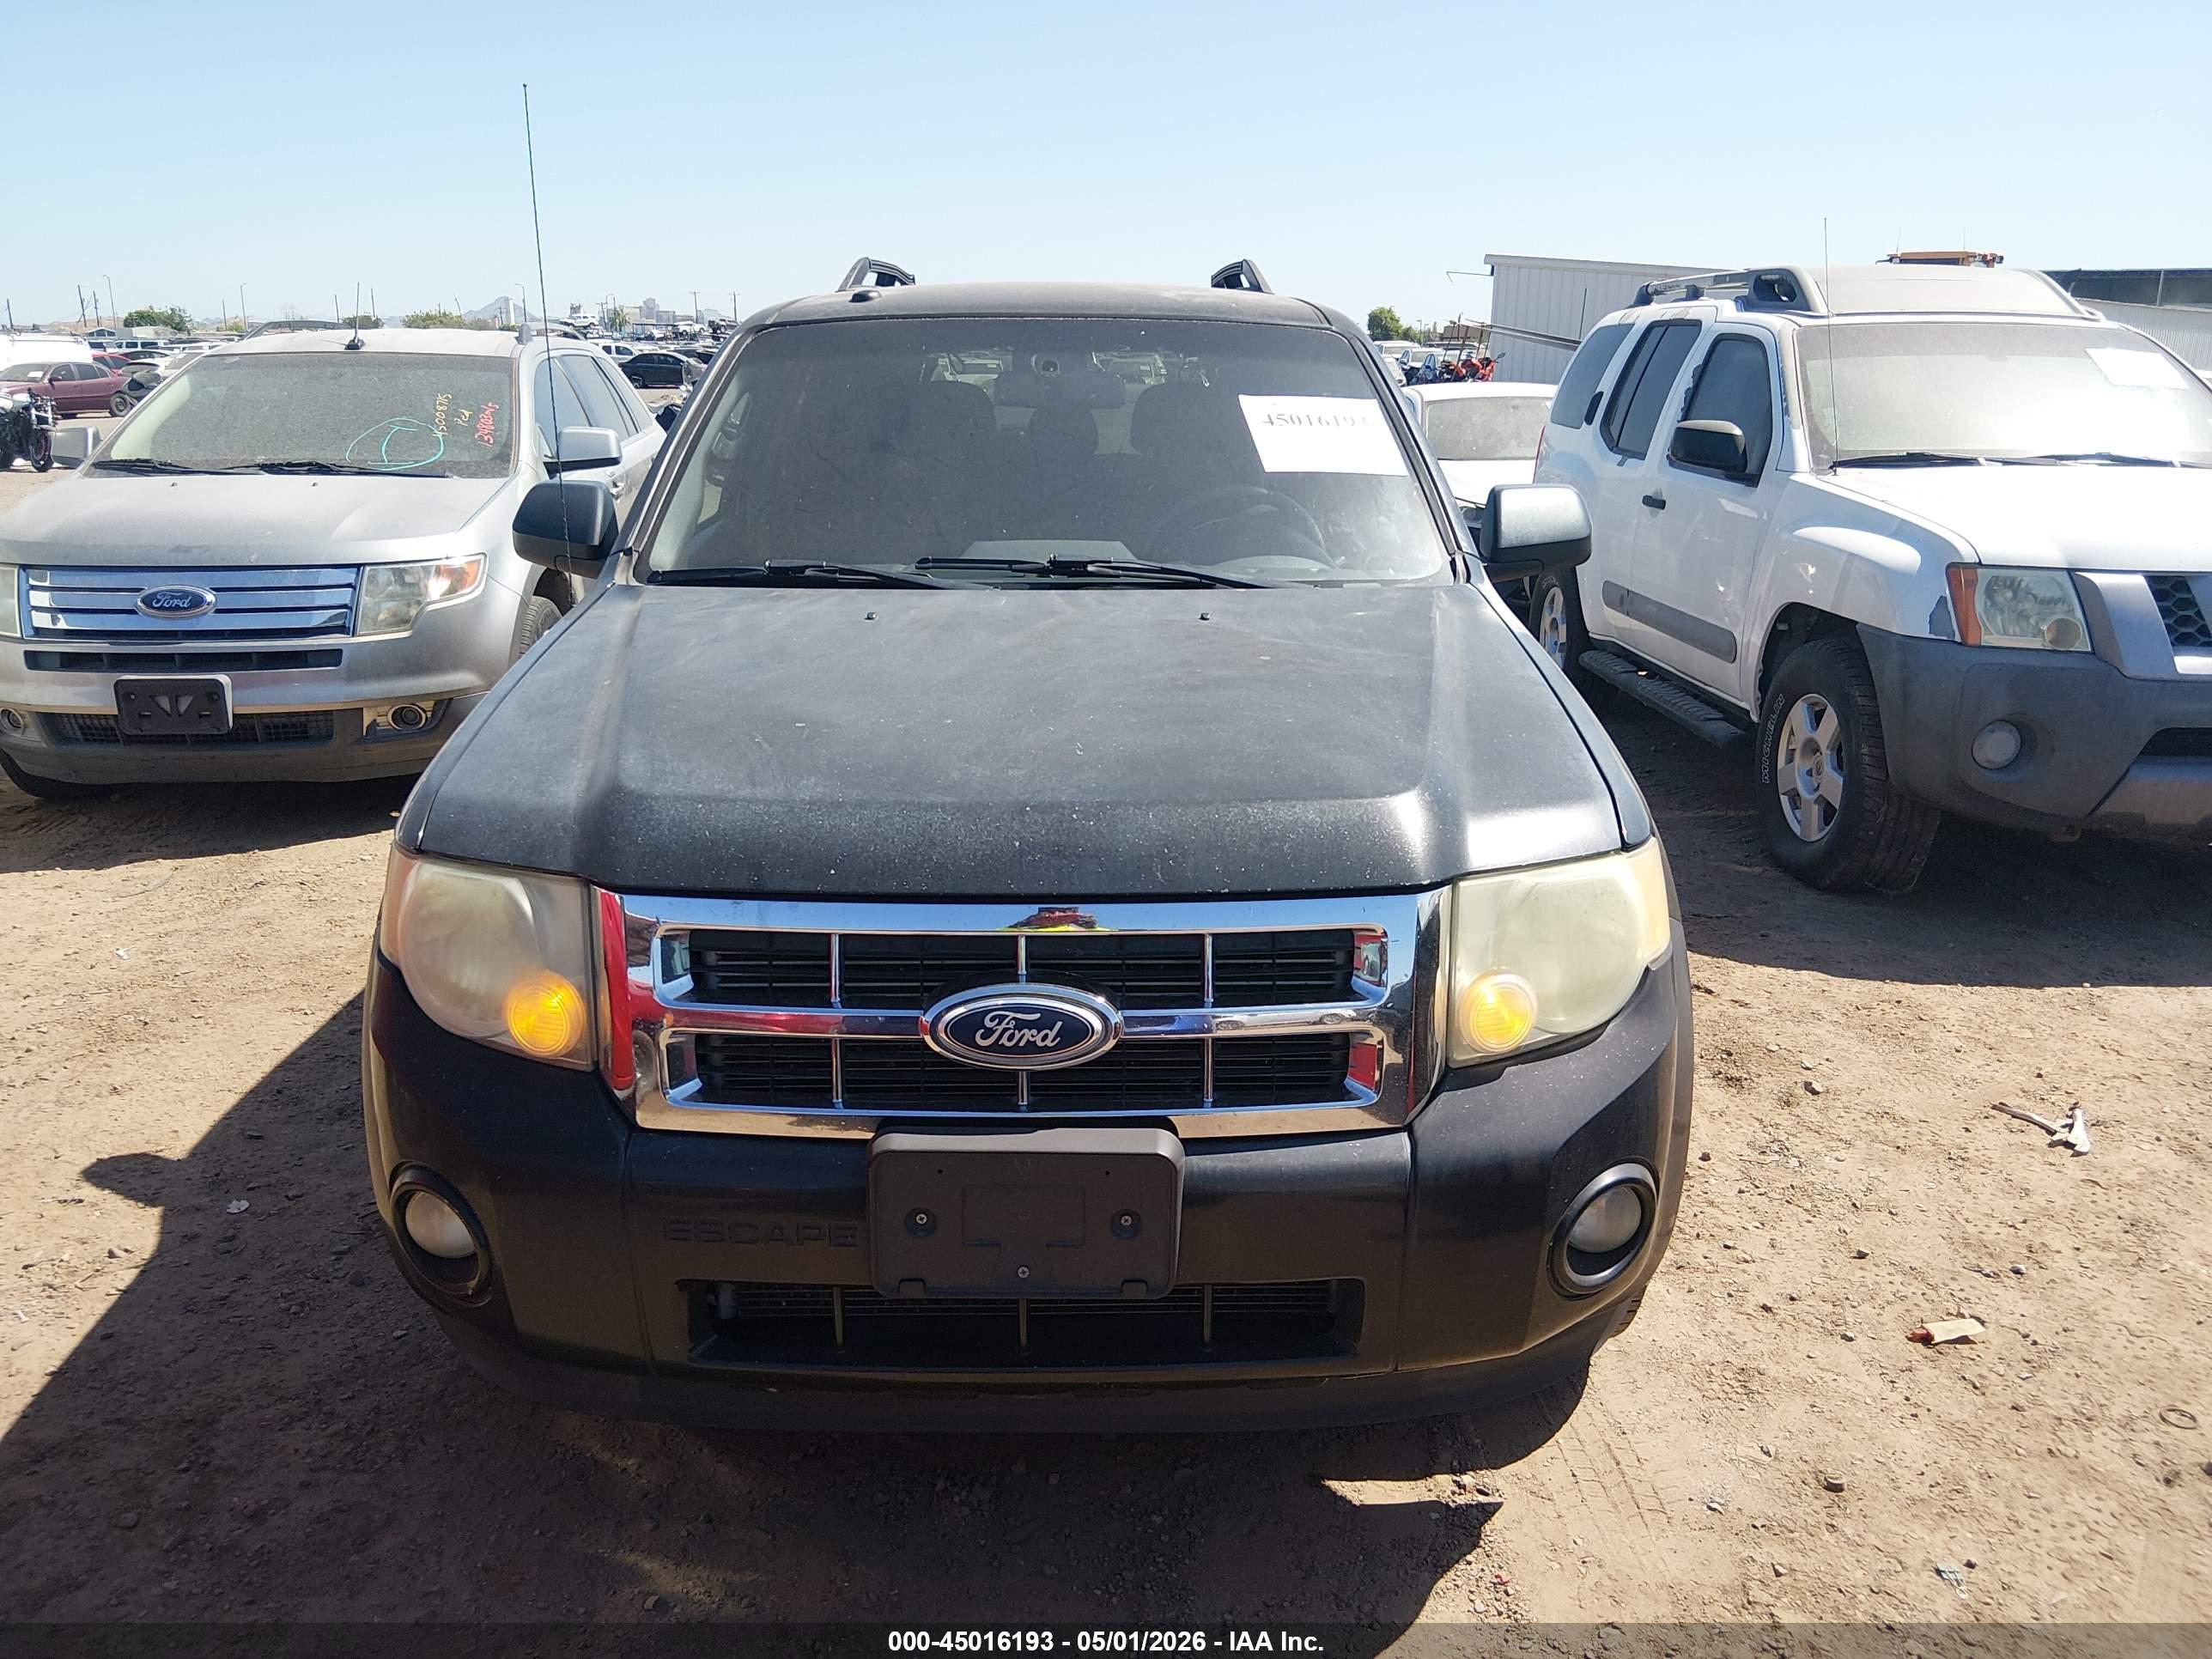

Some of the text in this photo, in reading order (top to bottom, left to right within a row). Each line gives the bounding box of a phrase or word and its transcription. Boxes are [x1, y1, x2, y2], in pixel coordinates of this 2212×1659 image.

[152, 592, 192, 608] Ford
[1761, 693, 1785, 783] MICHELIN
[975, 1011, 1063, 1047] Ford
[663, 1218, 859, 1247] ESCAPE
